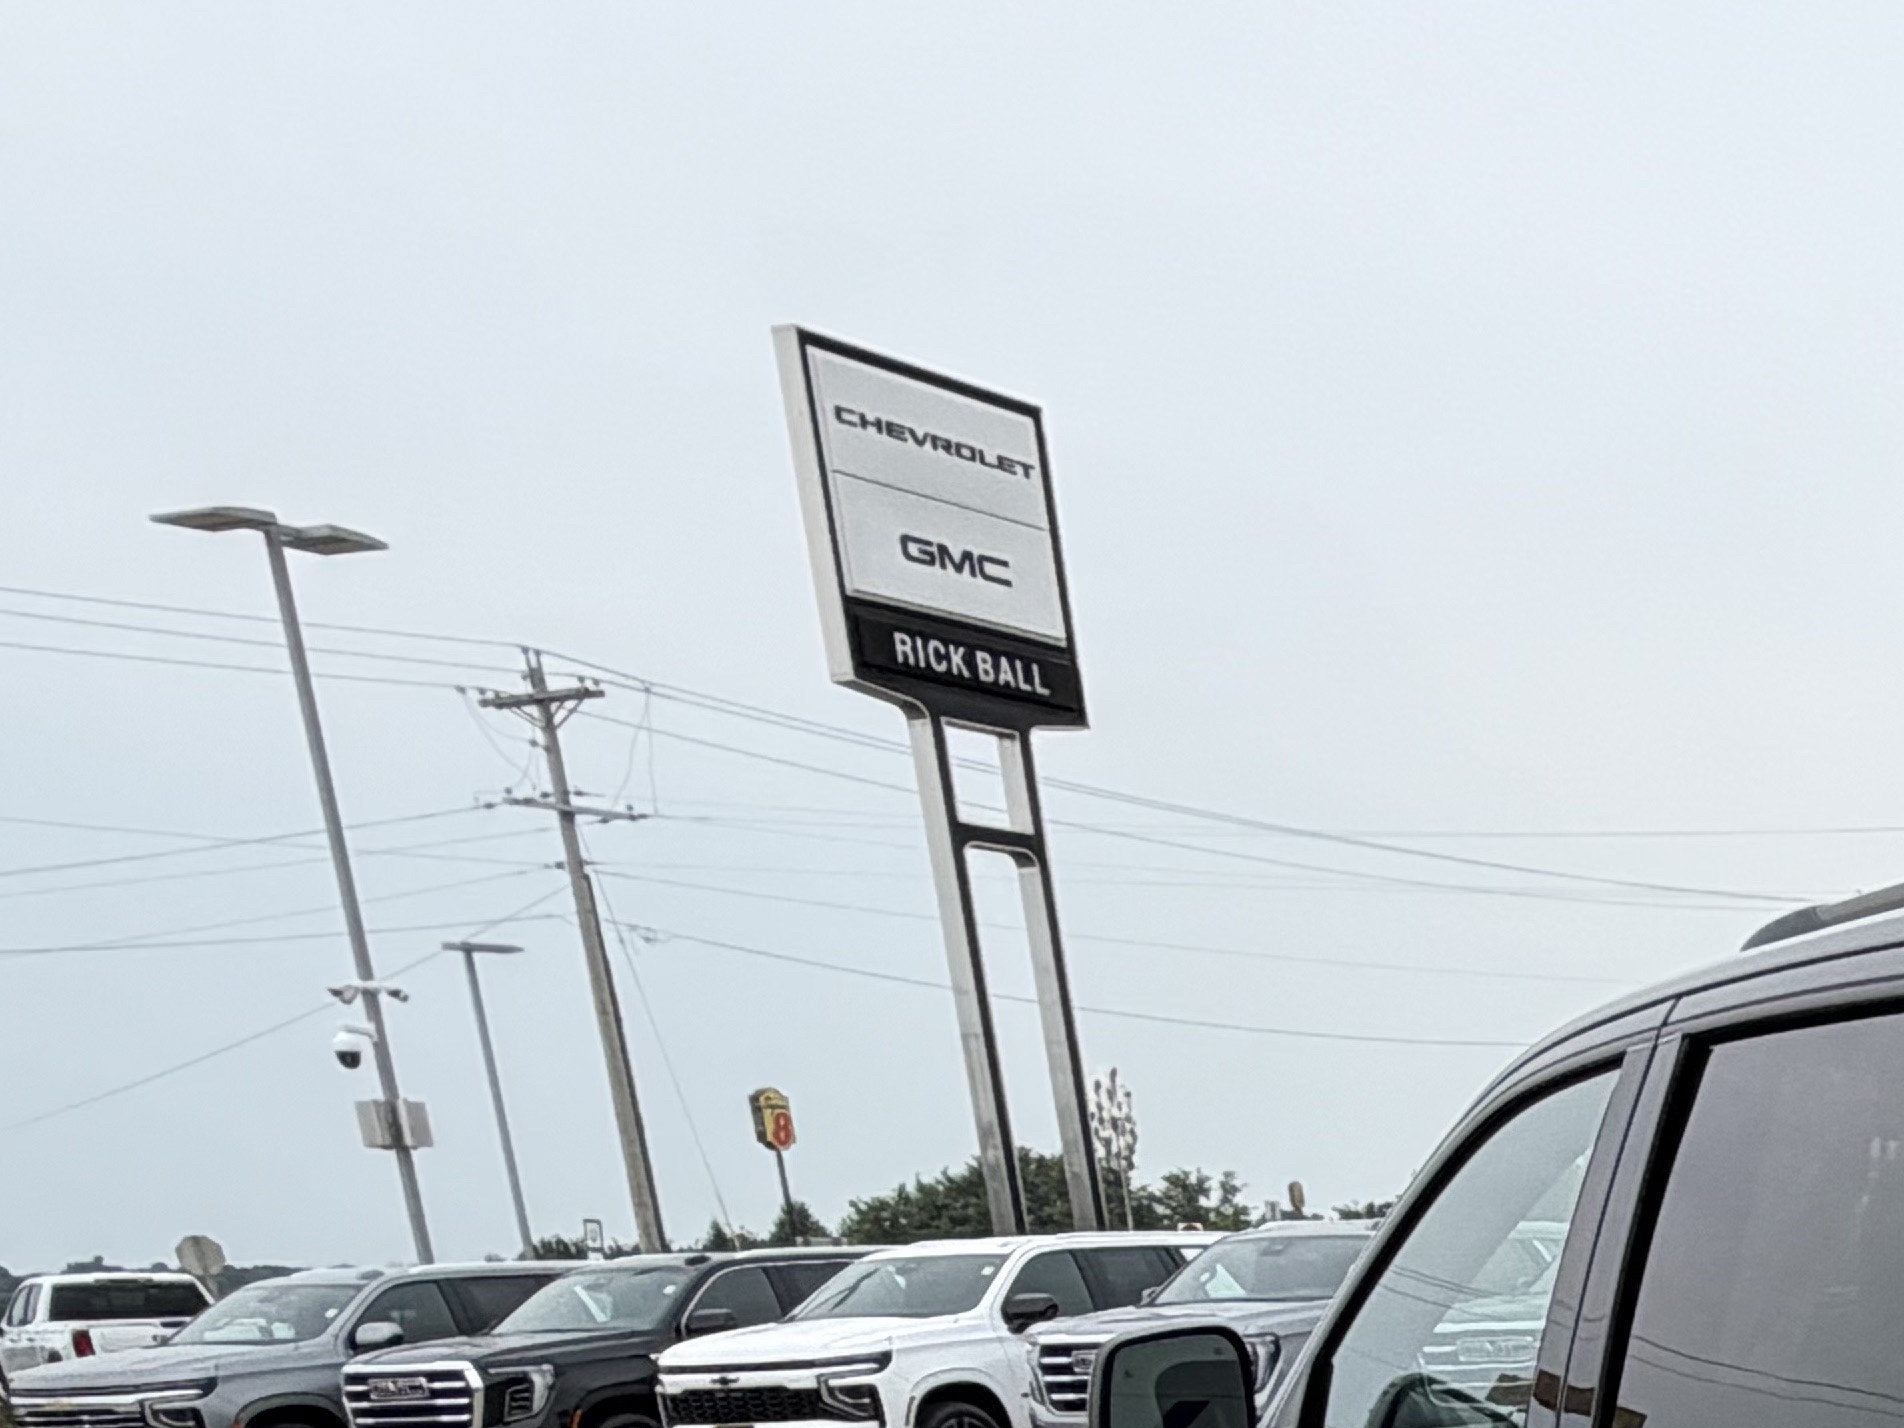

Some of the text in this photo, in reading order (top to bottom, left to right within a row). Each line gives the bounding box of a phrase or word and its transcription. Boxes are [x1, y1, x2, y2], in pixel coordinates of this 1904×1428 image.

[834, 404, 1036, 480] CHEVROLET
[899, 533, 1014, 588] GMC
[893, 630, 1051, 697] RICK BALL
